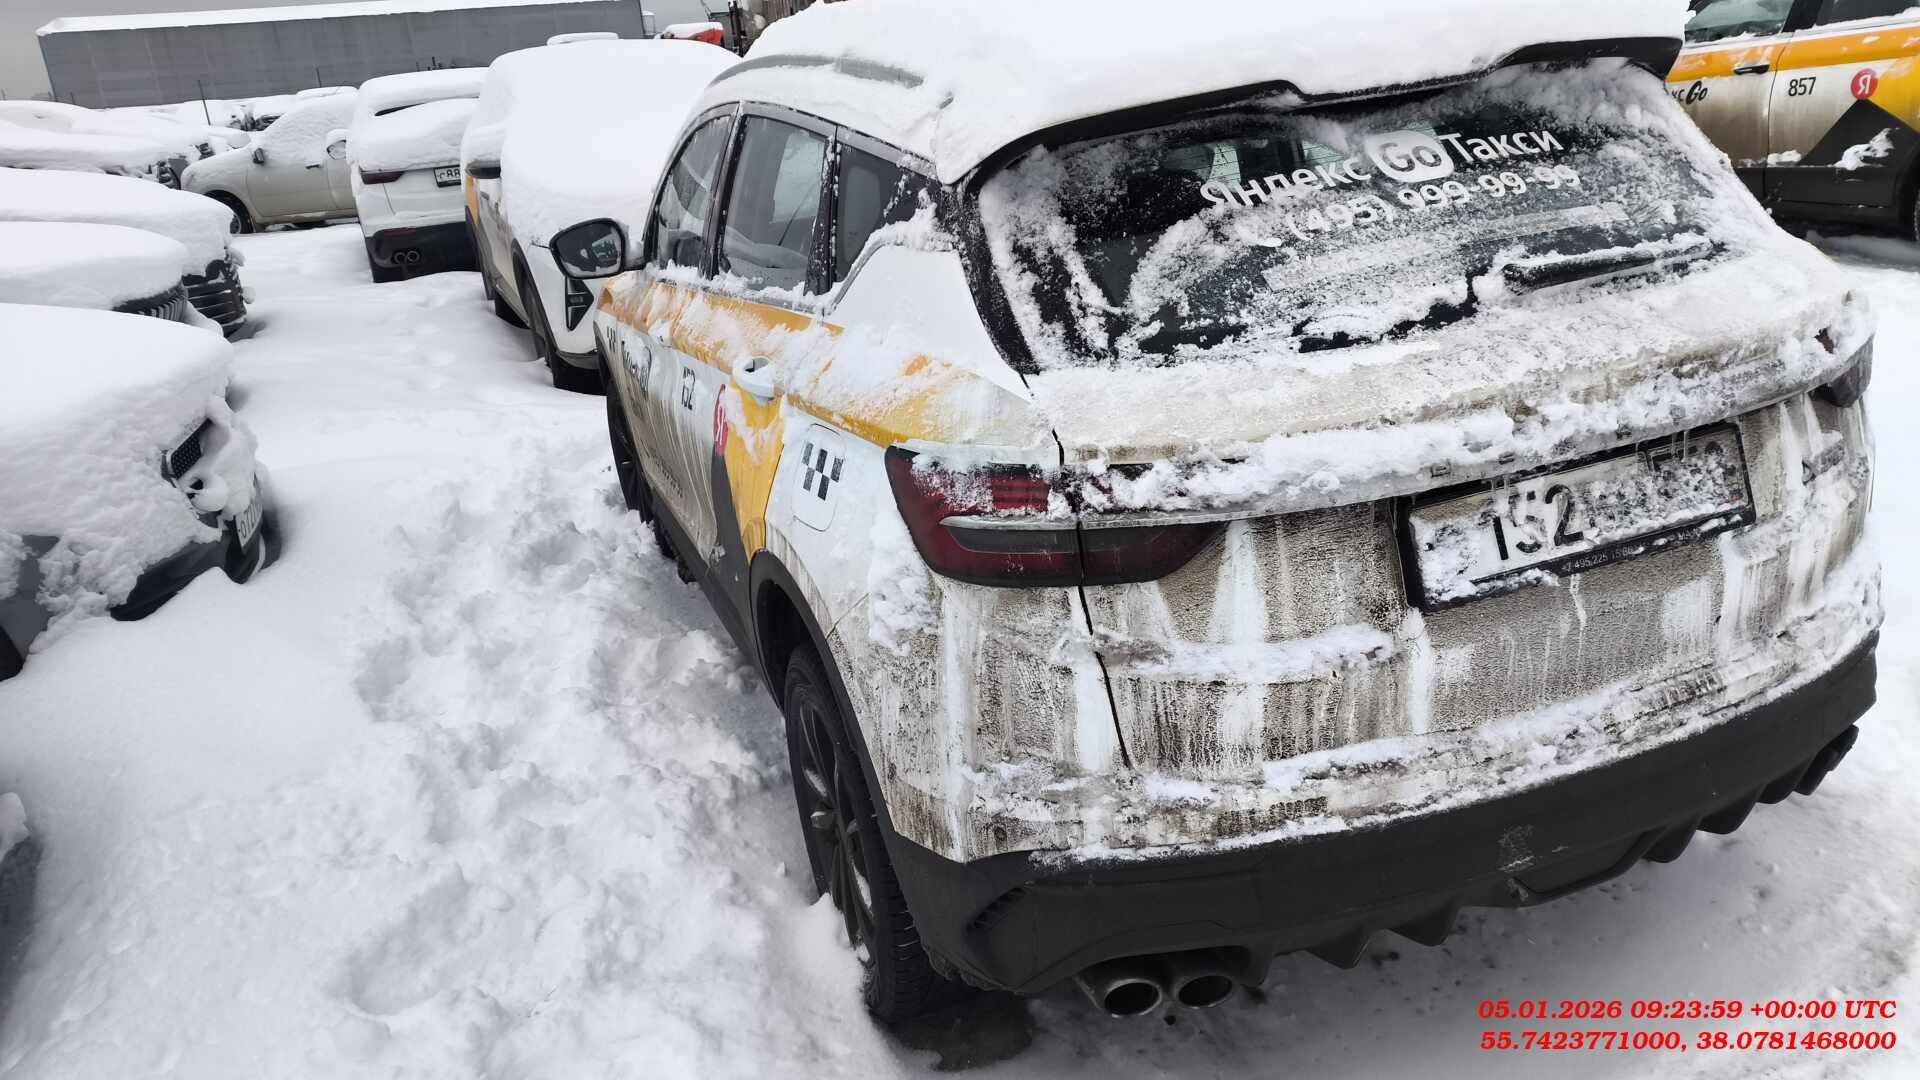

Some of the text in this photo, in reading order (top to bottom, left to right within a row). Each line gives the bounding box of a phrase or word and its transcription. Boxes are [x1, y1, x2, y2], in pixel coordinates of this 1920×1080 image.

[1685, 80, 1708, 104] Go
[1788, 76, 1817, 97] 857
[1857, 74, 1872, 95] Я
[1199, 157, 1372, 209] Яндекс
[1437, 130, 1564, 164] Такси
[1285, 163, 1581, 241] (495) 999-99-99
